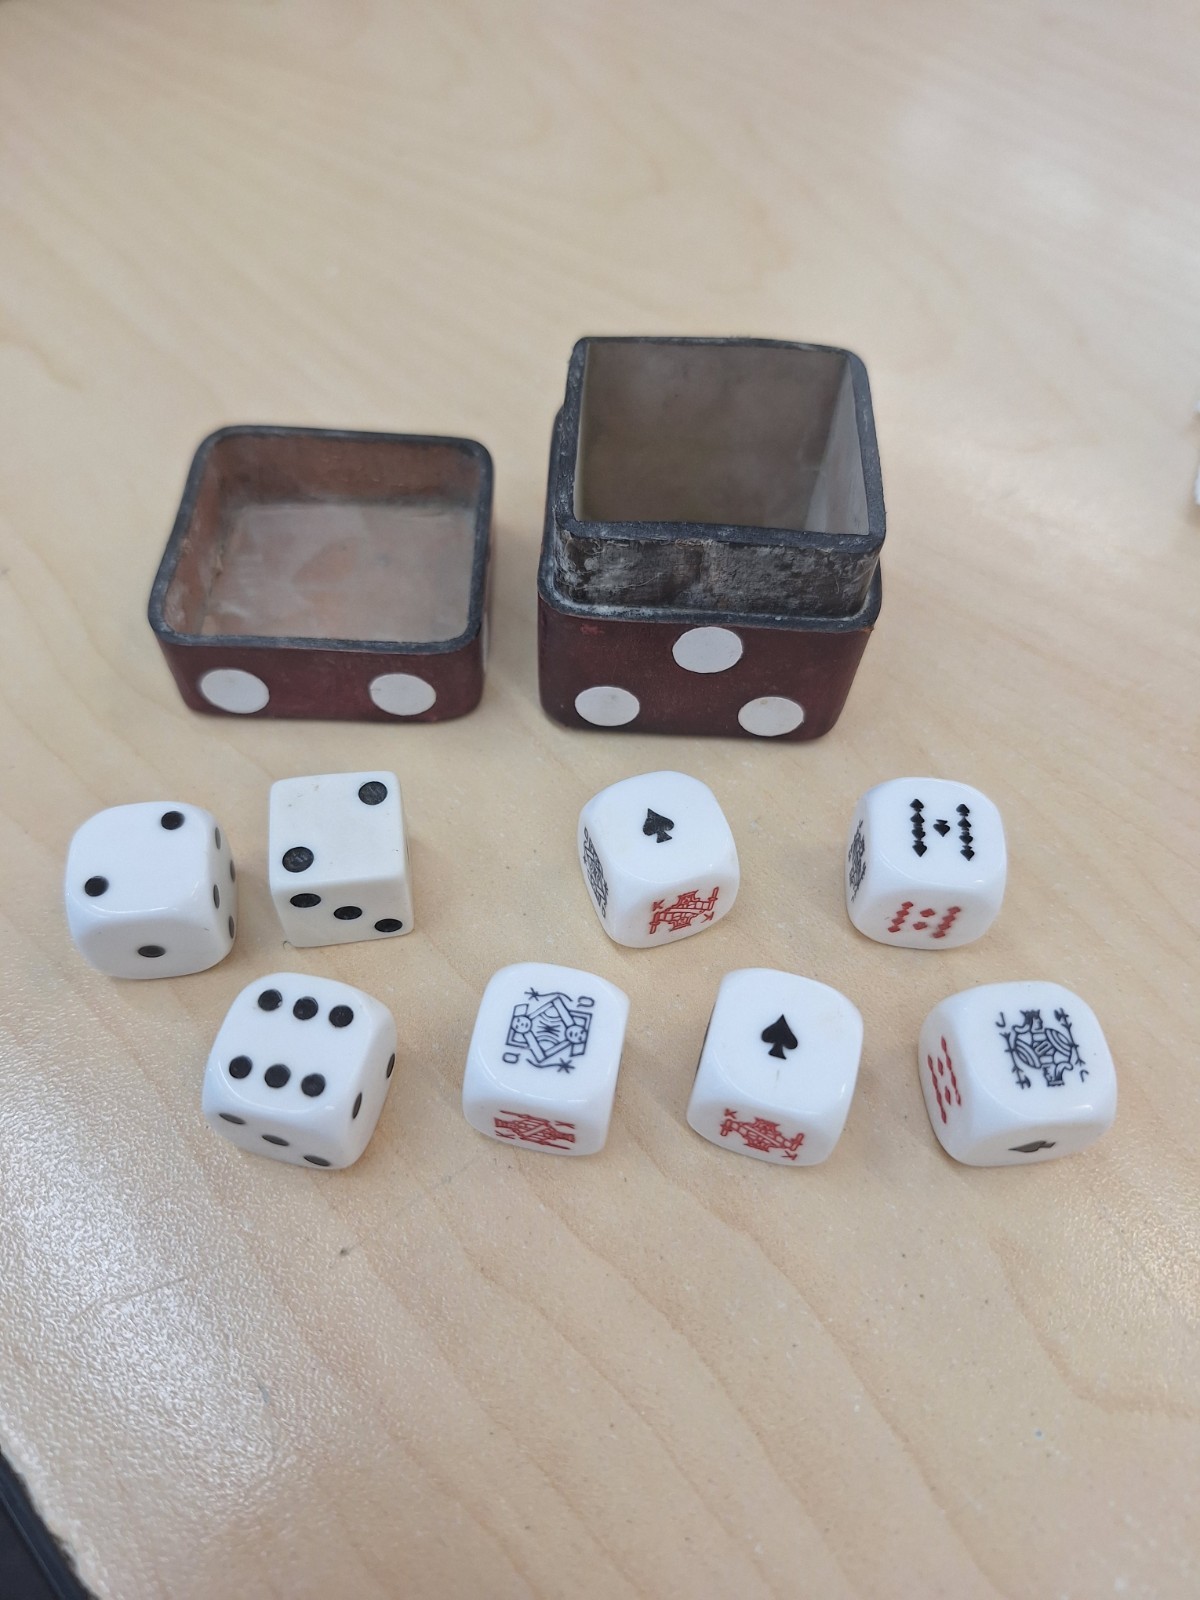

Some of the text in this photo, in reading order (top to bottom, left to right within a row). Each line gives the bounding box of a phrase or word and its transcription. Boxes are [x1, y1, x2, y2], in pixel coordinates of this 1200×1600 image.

[652, 899, 665, 911] K
[995, 1011, 1006, 1028] J
[724, 1108, 738, 1119] K
